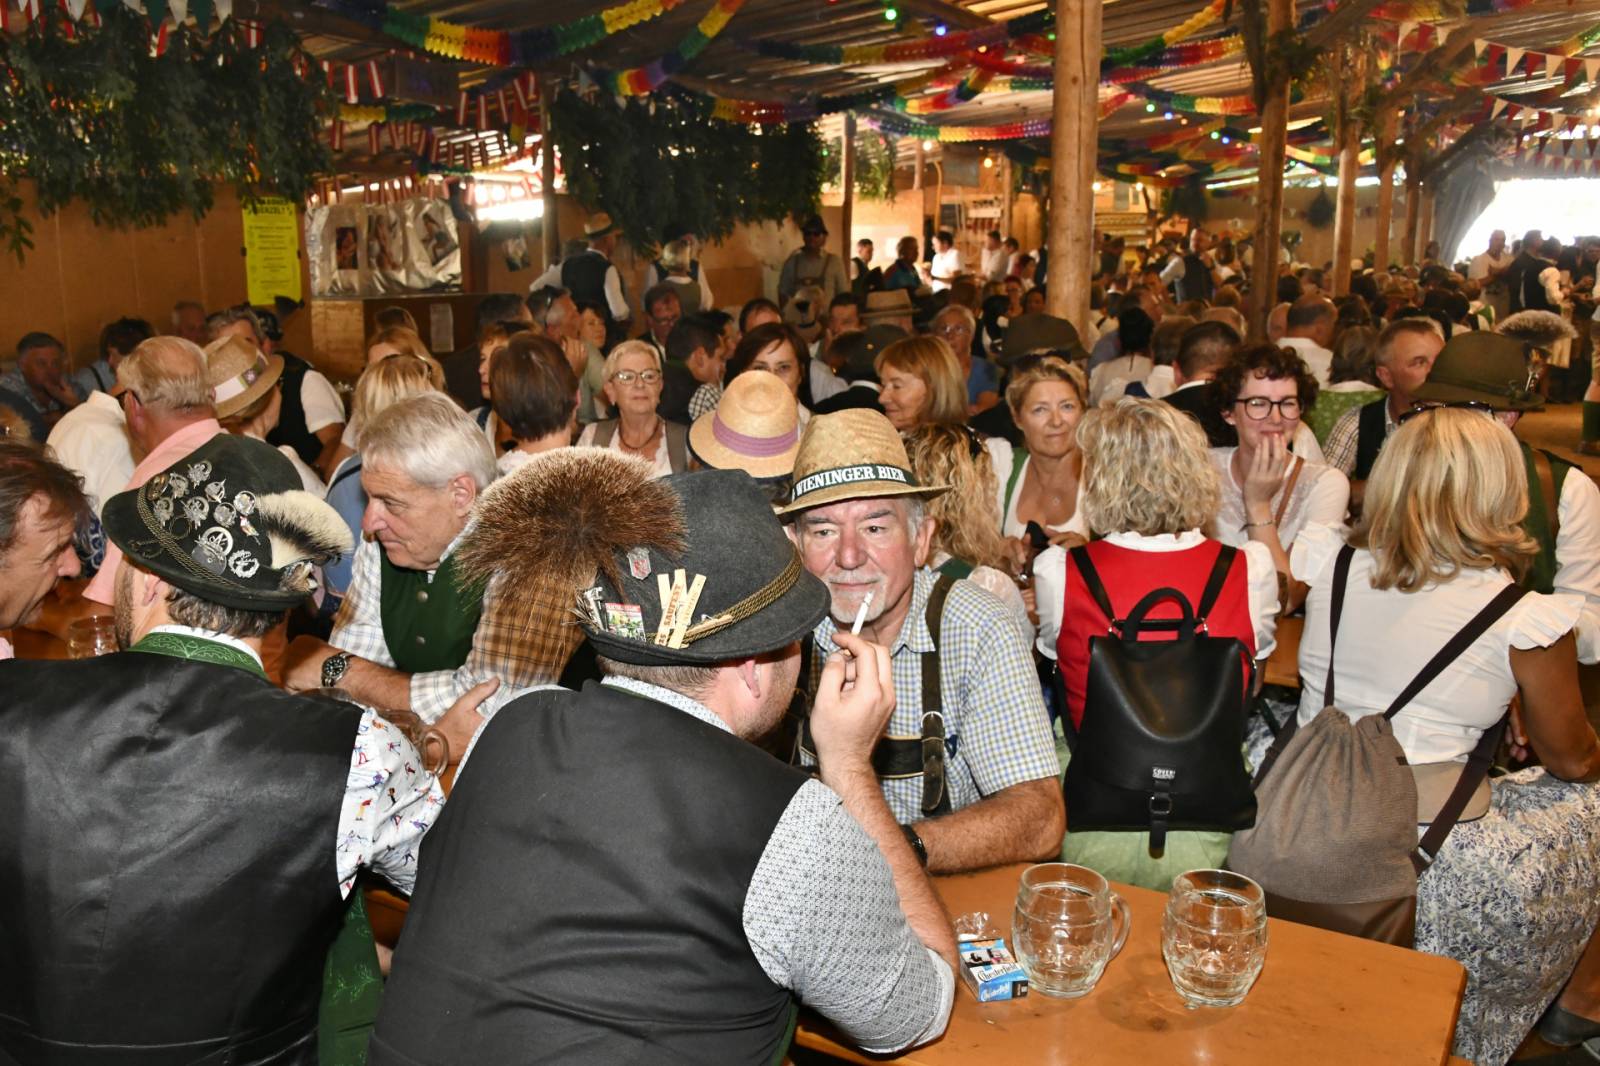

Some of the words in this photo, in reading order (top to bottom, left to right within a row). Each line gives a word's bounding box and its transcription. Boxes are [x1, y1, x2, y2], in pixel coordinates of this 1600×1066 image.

[795, 466, 876, 497] WIENINGER
[876, 465, 906, 482] BIER
[977, 962, 1018, 983] Chesterfield
